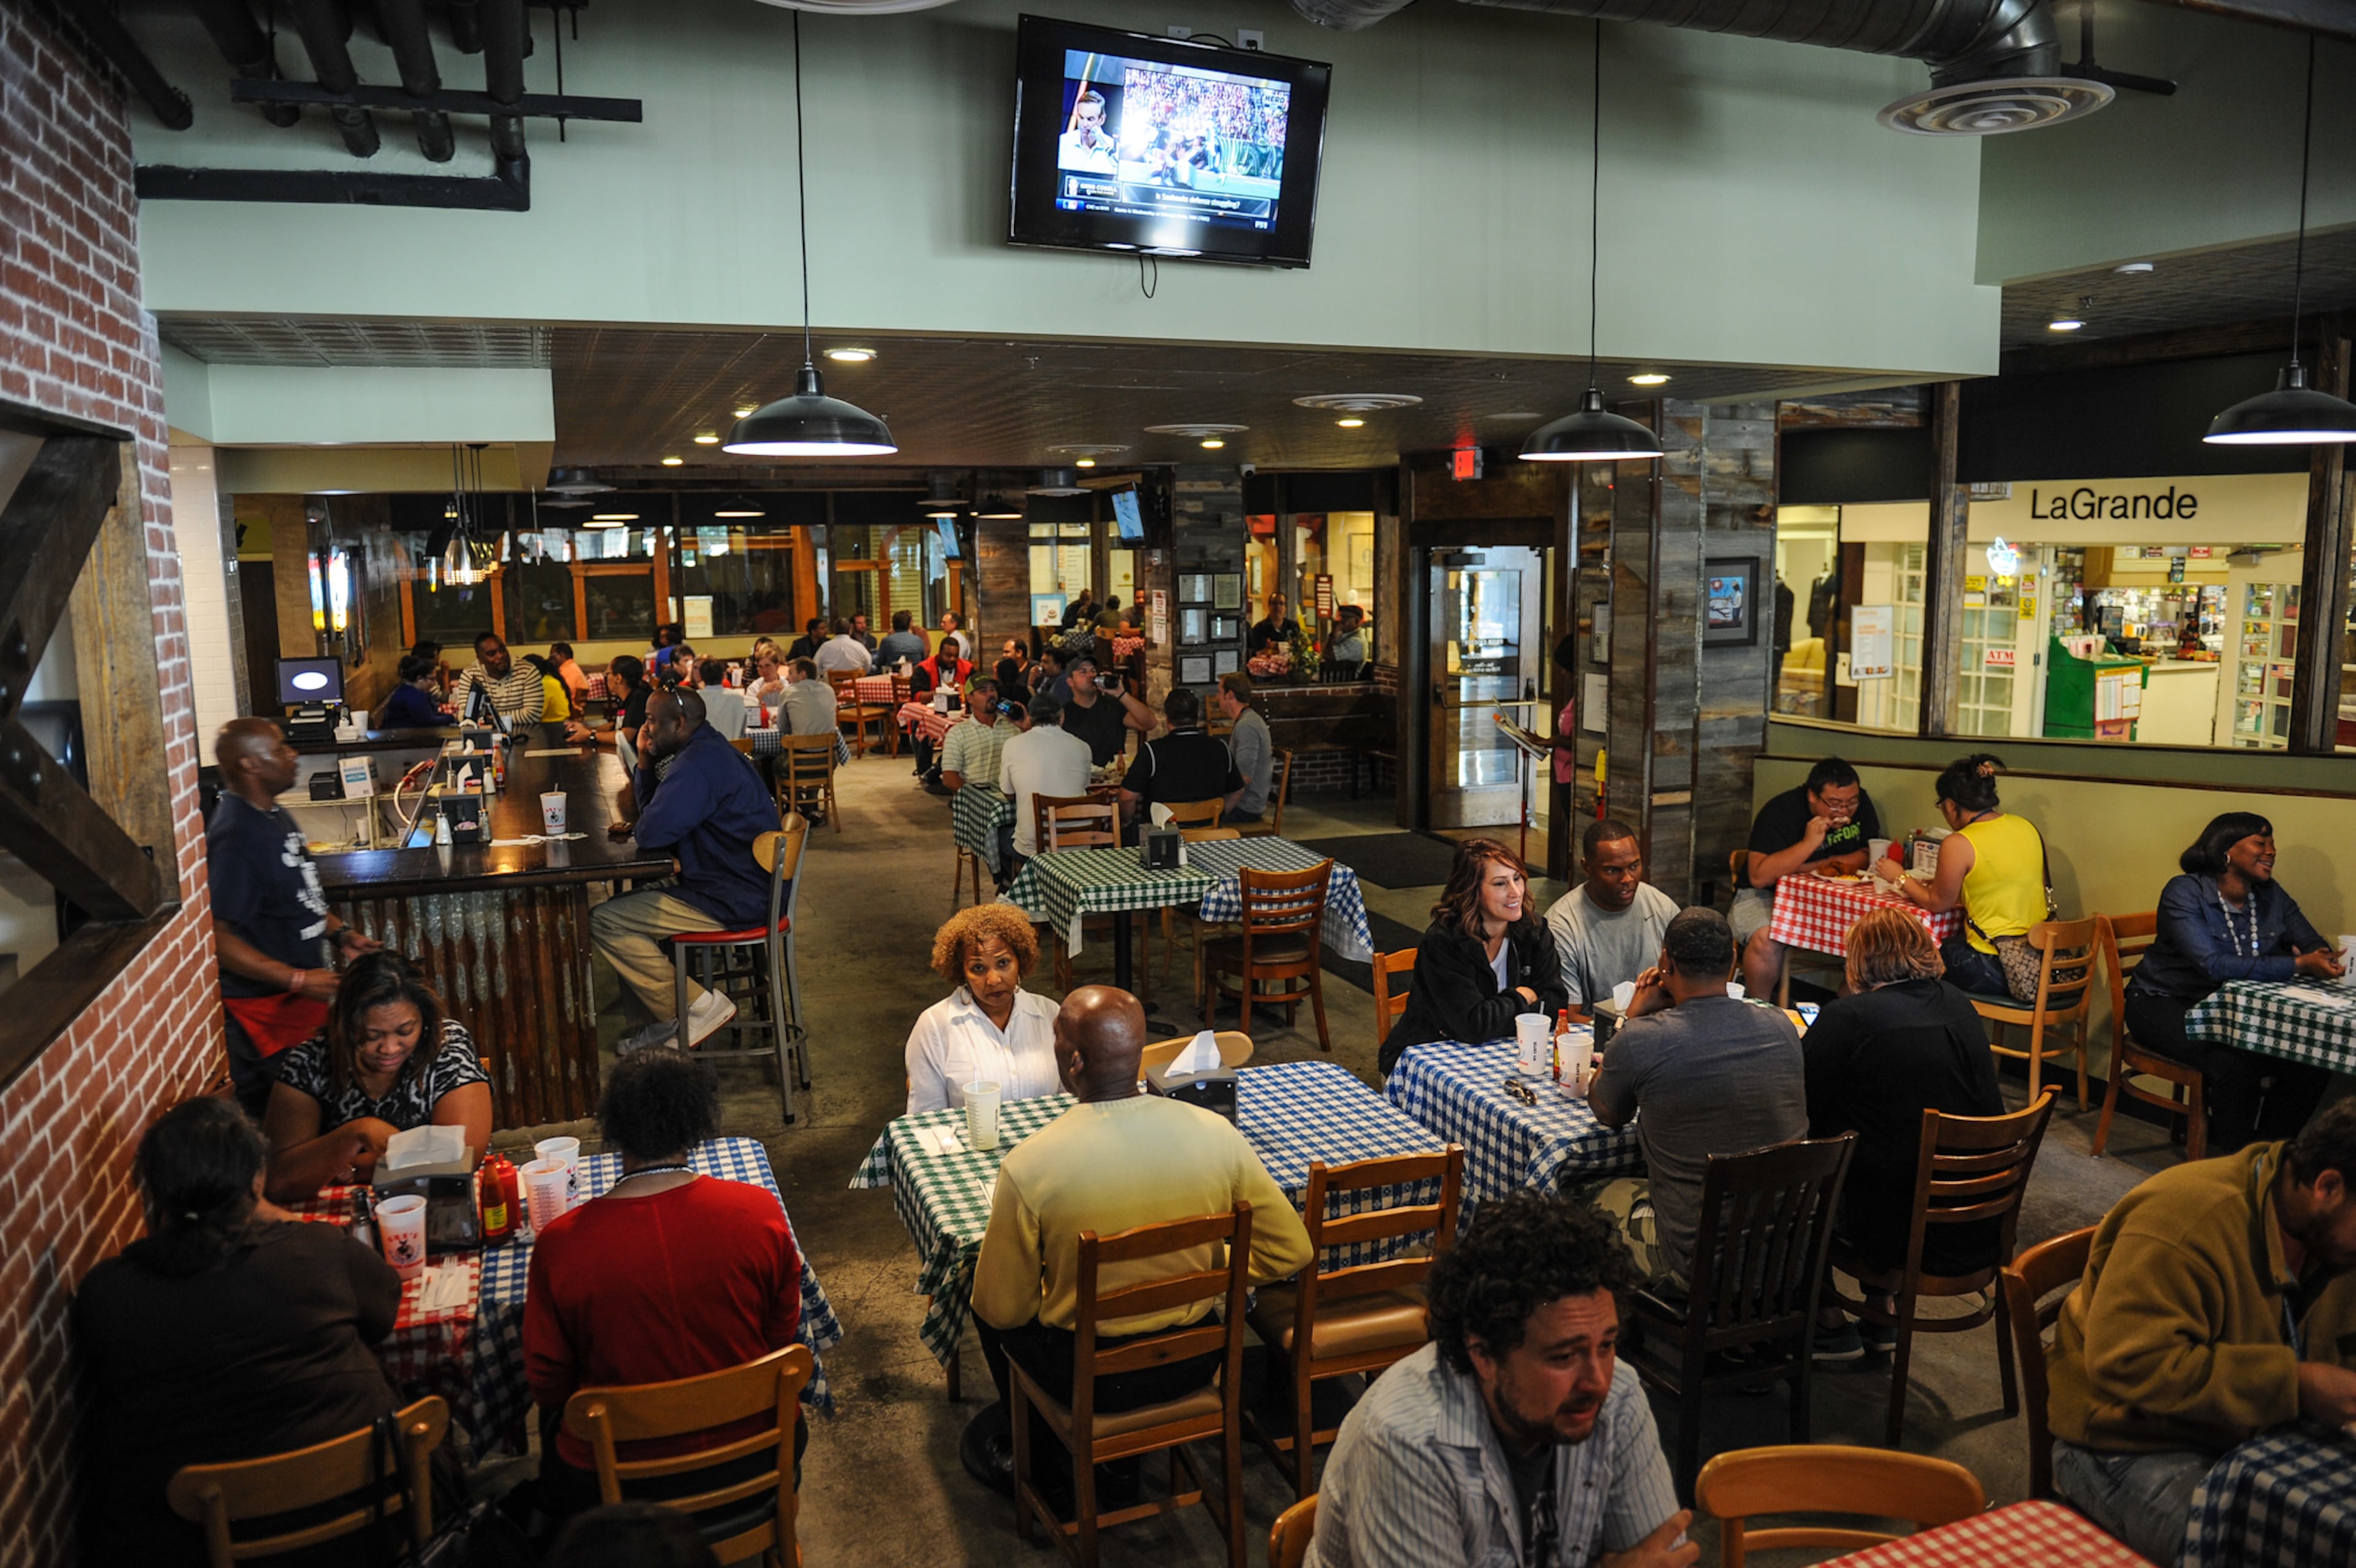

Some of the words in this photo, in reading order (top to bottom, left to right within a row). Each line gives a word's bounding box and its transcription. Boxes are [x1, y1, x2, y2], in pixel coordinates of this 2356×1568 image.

[1161, 193, 1188, 202] Seahawks
[1189, 196, 1210, 206] defense
[1211, 199, 1241, 210] struggling?
[1254, 220, 1268, 229] FS1
[2031, 486, 2198, 520] LaGrande
[1987, 650, 2015, 660] ATM
